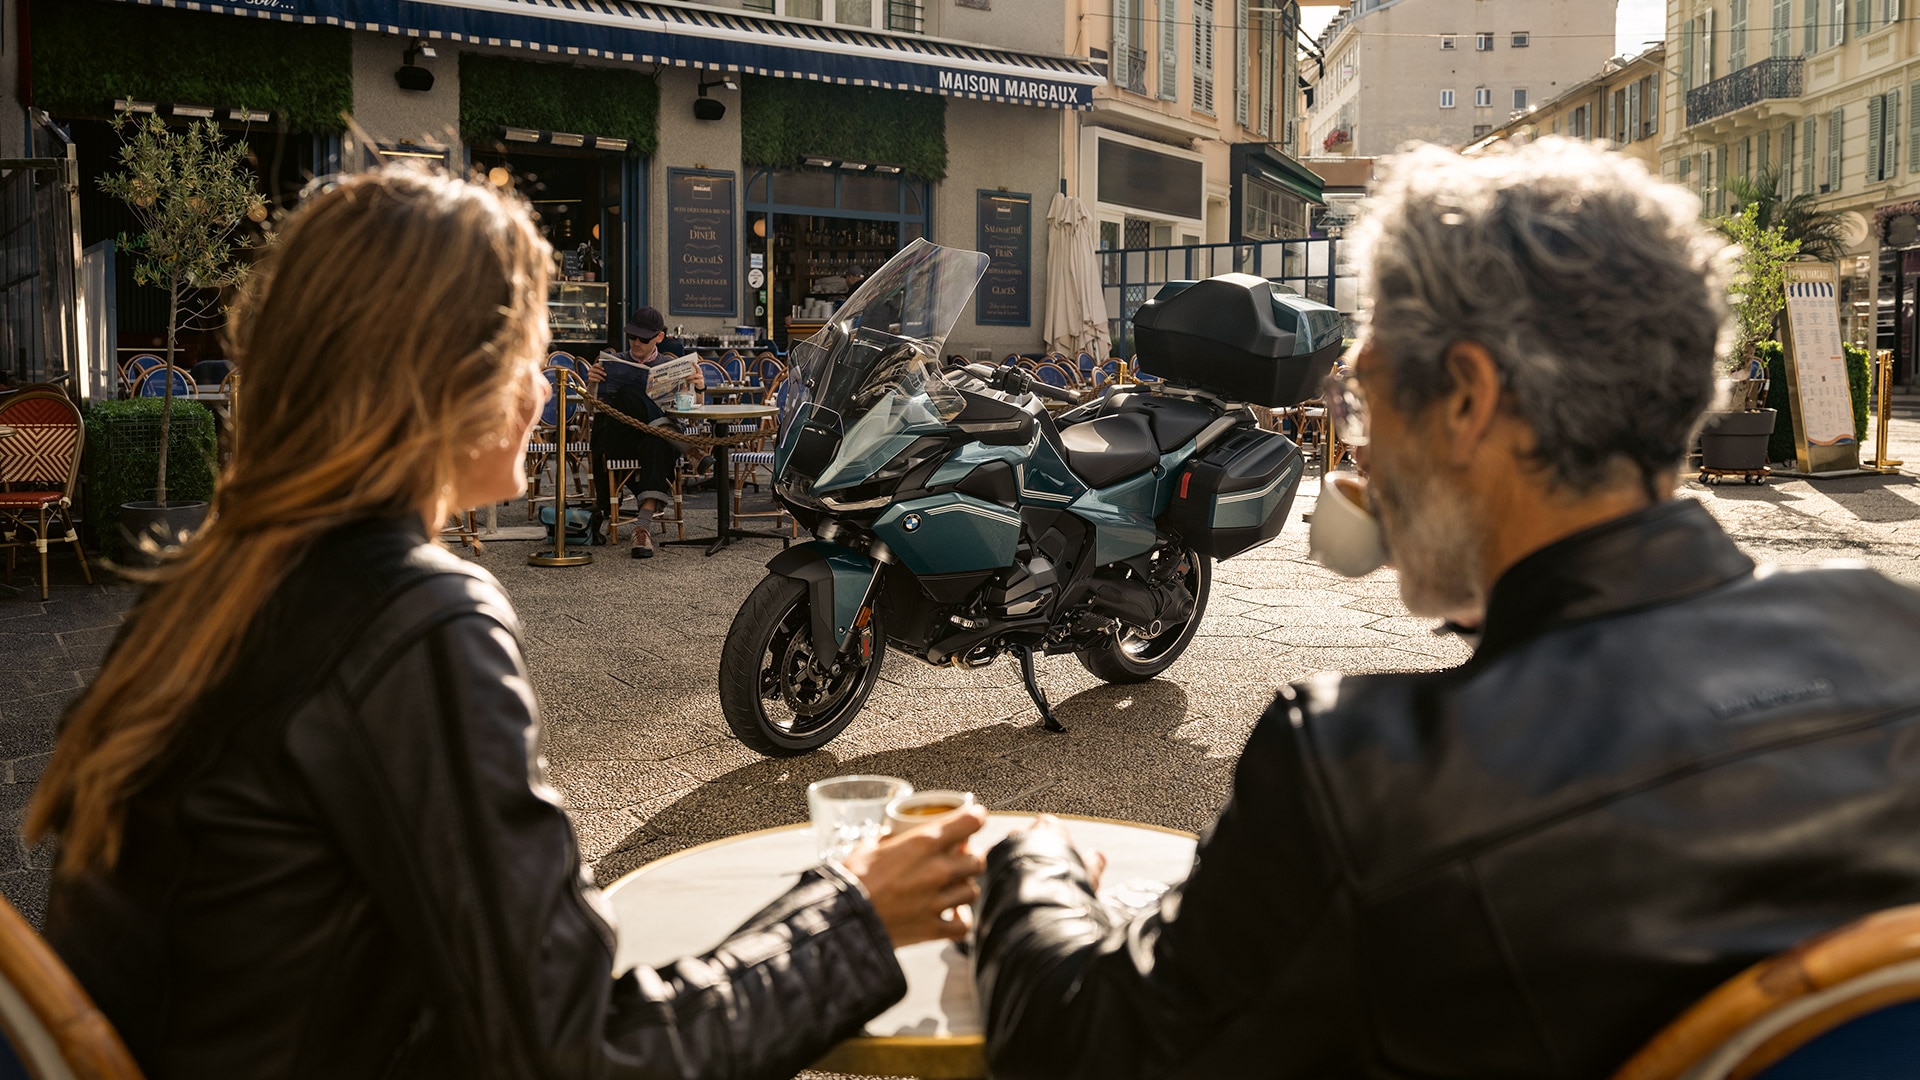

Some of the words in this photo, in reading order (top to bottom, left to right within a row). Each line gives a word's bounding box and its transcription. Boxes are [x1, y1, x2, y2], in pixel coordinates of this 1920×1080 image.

[939, 71, 999, 94] MAISON
[1005, 79, 1078, 103] MARGAUX
[683, 253, 723, 264] COCKTAILS
